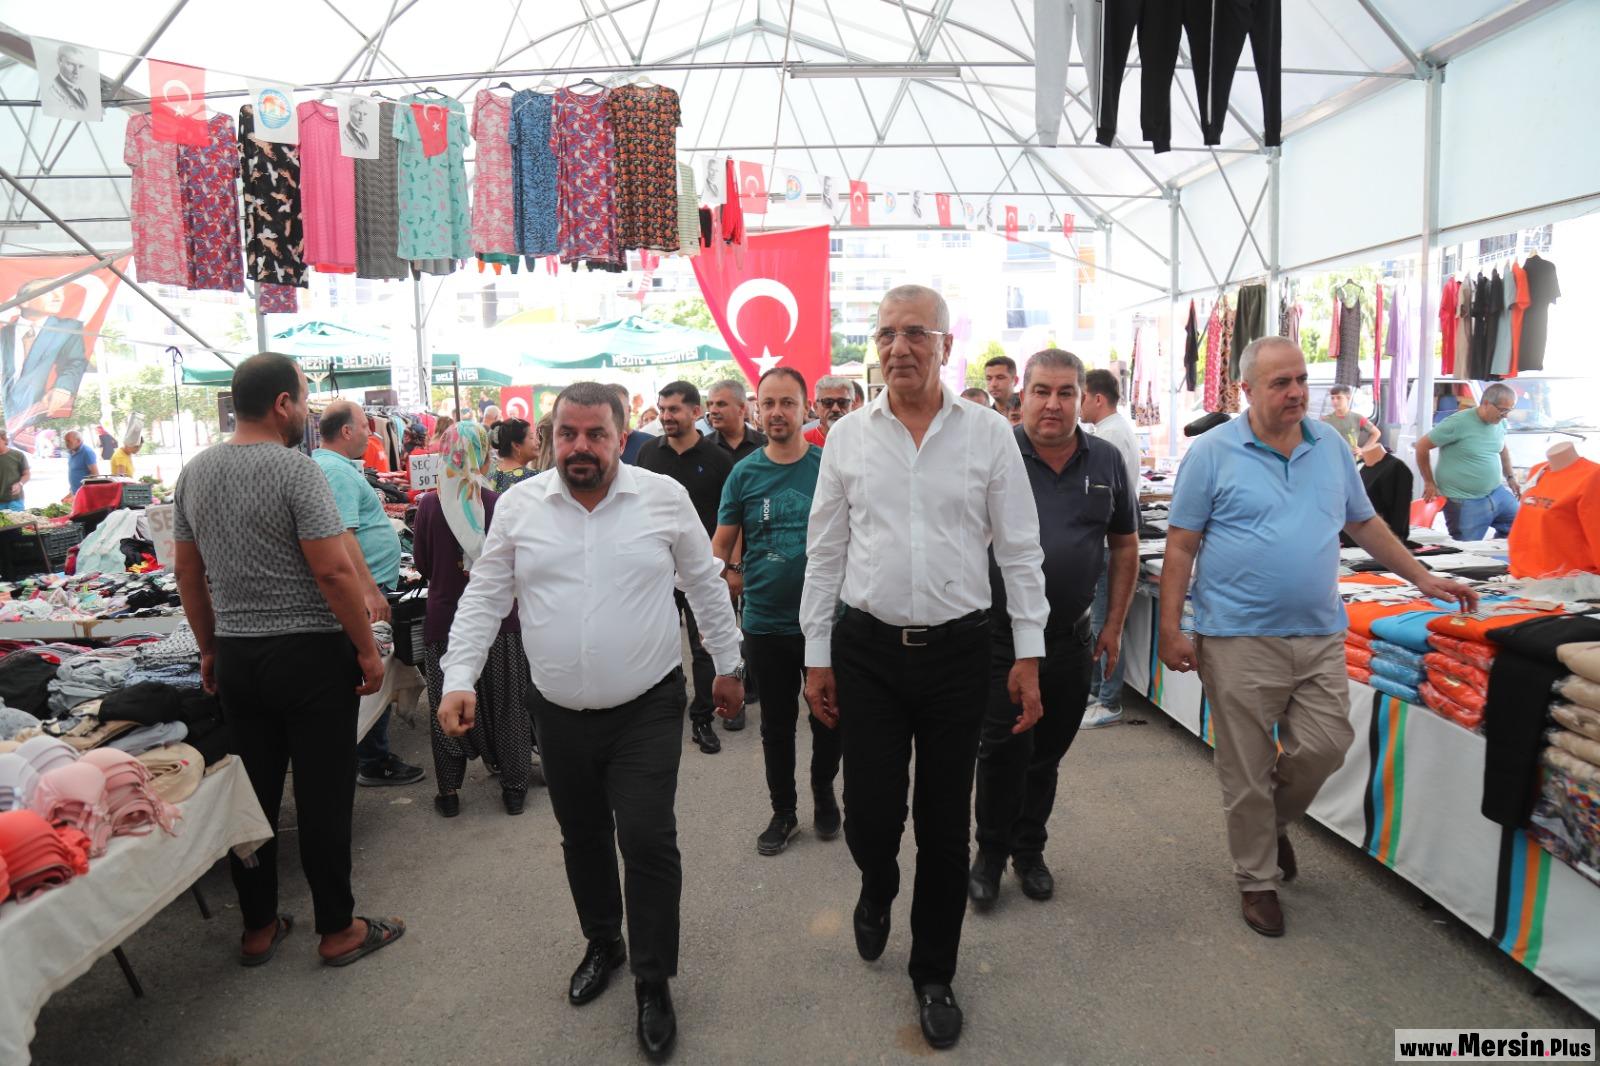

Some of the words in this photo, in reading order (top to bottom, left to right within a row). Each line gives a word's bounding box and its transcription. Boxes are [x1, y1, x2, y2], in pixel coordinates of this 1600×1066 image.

[412, 459, 431, 471] SEÇ
[419, 475, 430, 486] 50
[150, 509, 173, 533] SE
